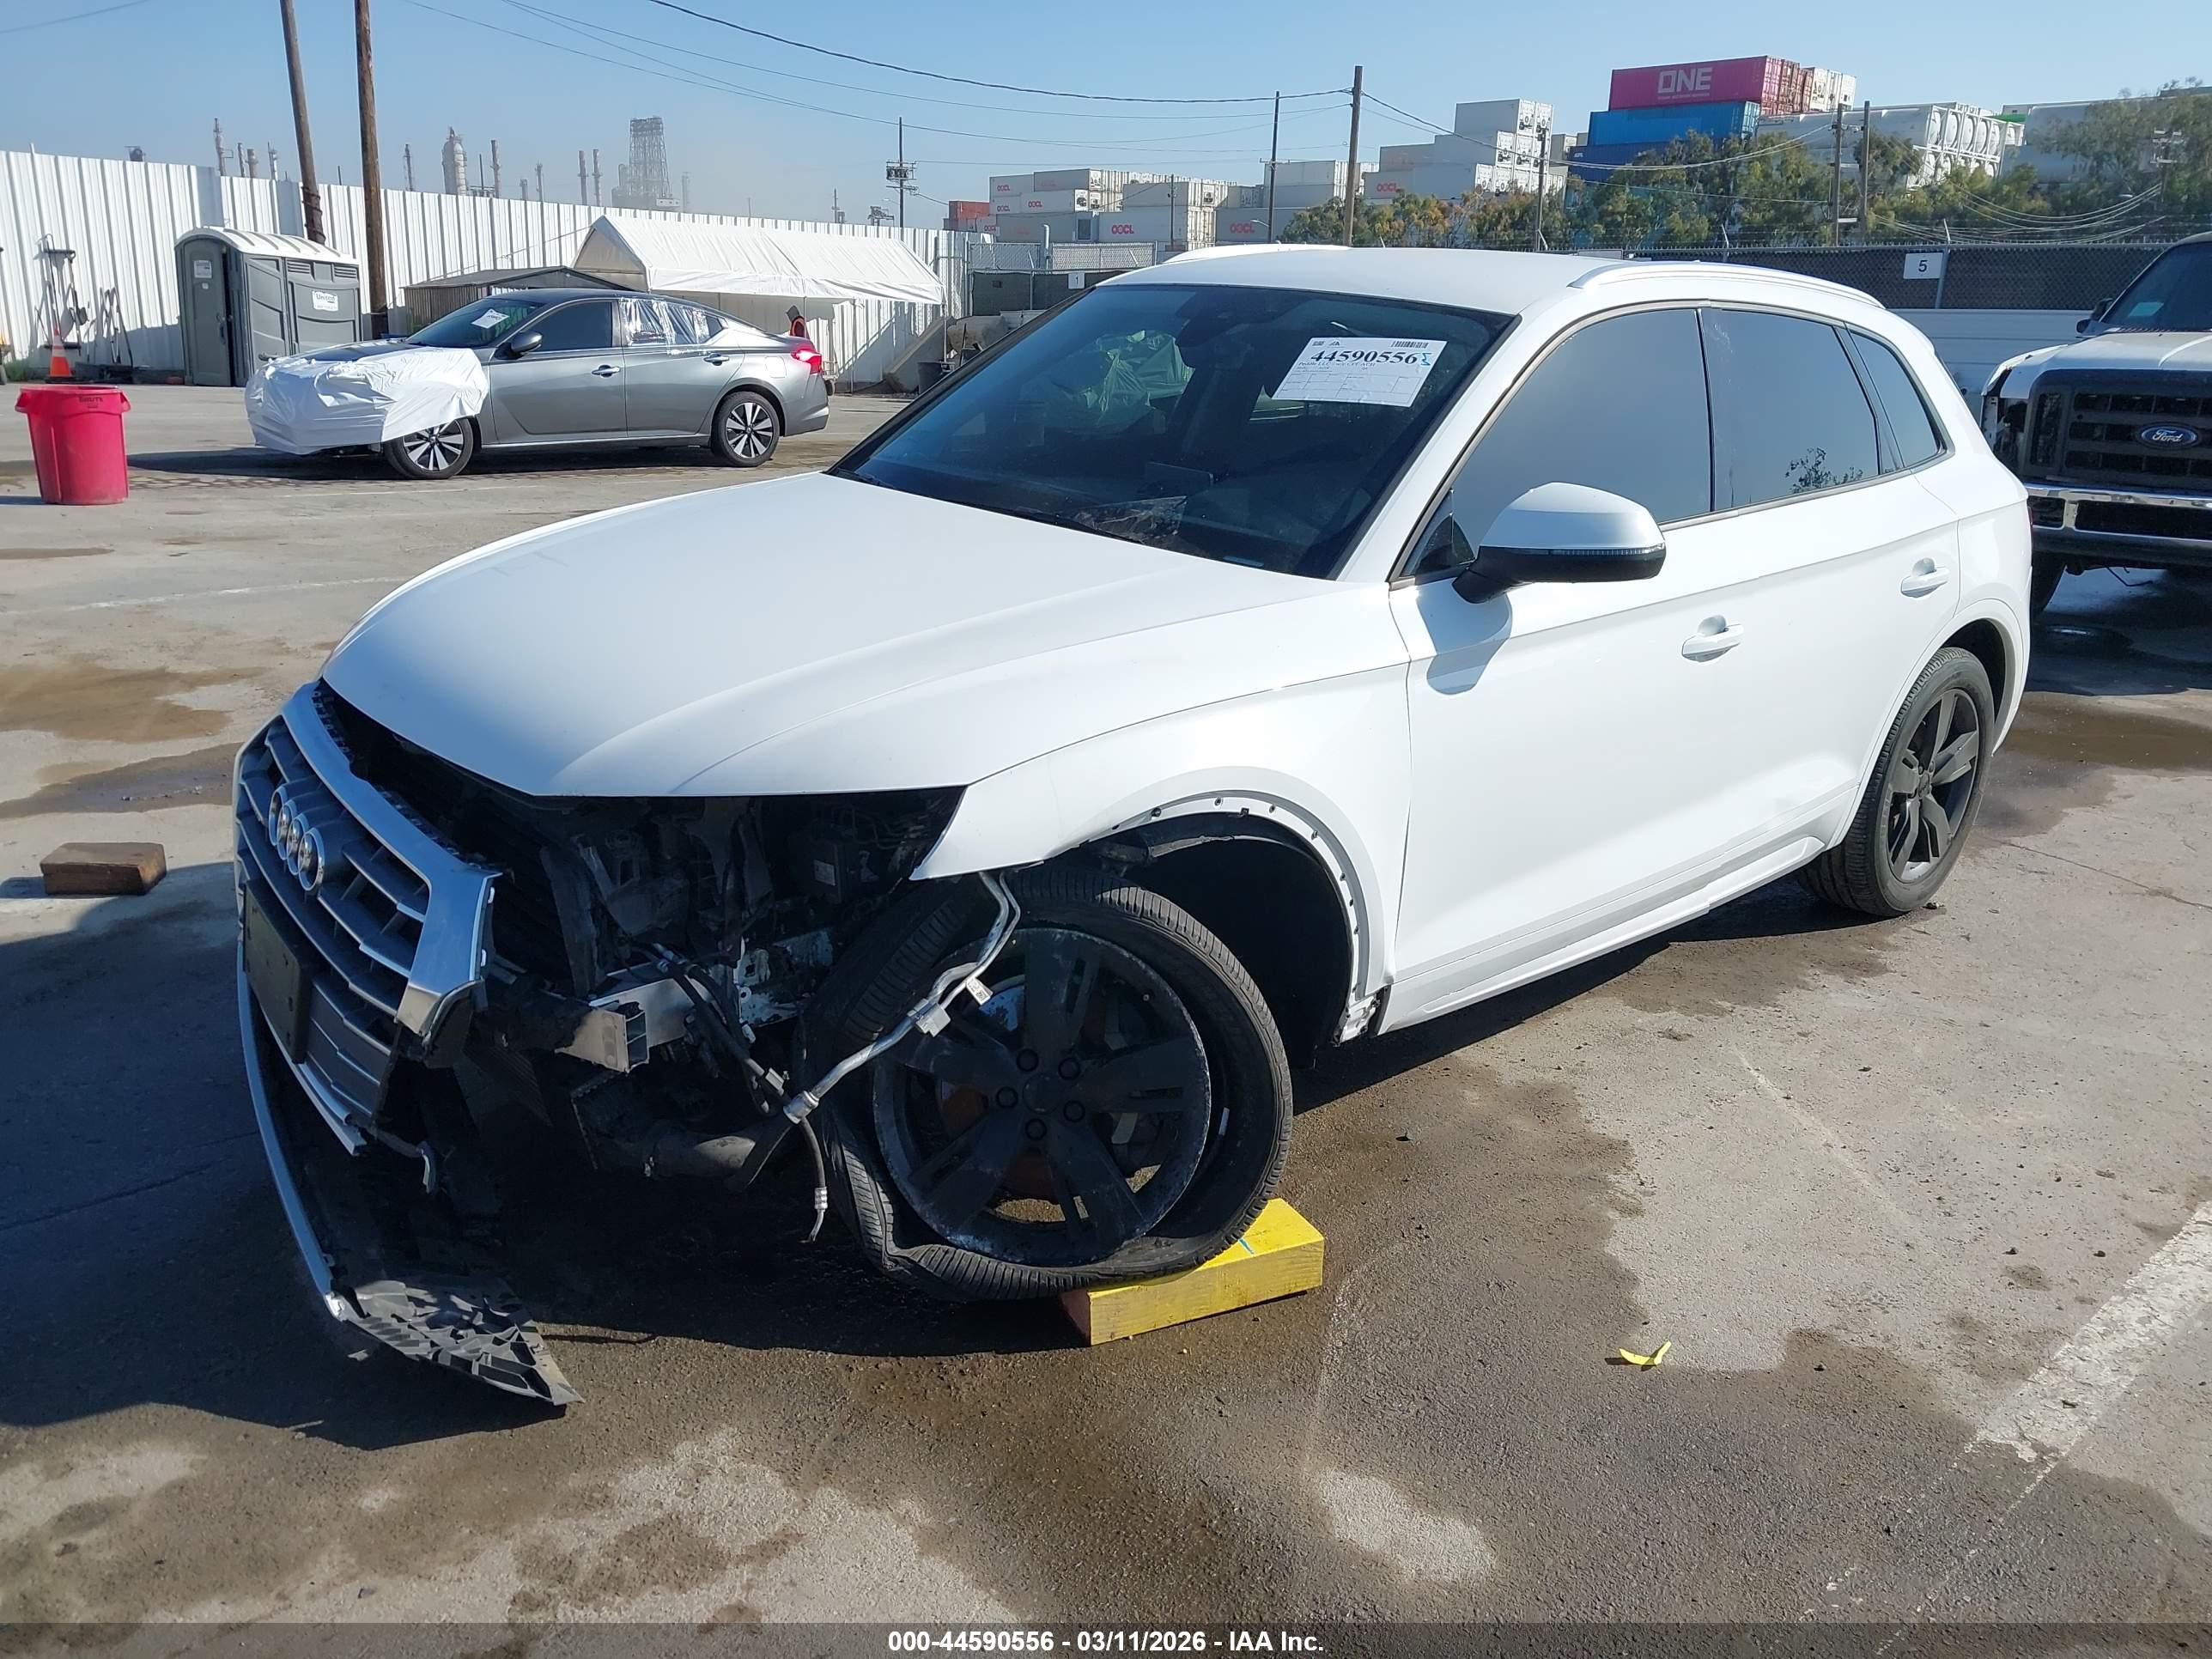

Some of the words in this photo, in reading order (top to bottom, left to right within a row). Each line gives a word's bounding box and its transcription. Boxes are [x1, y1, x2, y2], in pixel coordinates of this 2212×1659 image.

[1657, 67, 1713, 94] ONE
[1111, 224, 1134, 234] OOCL
[1230, 223, 1255, 234] OOCL
[1918, 259, 1929, 272] 5
[1310, 350, 1418, 365] 44590556
[2152, 428, 2184, 442] Ford
